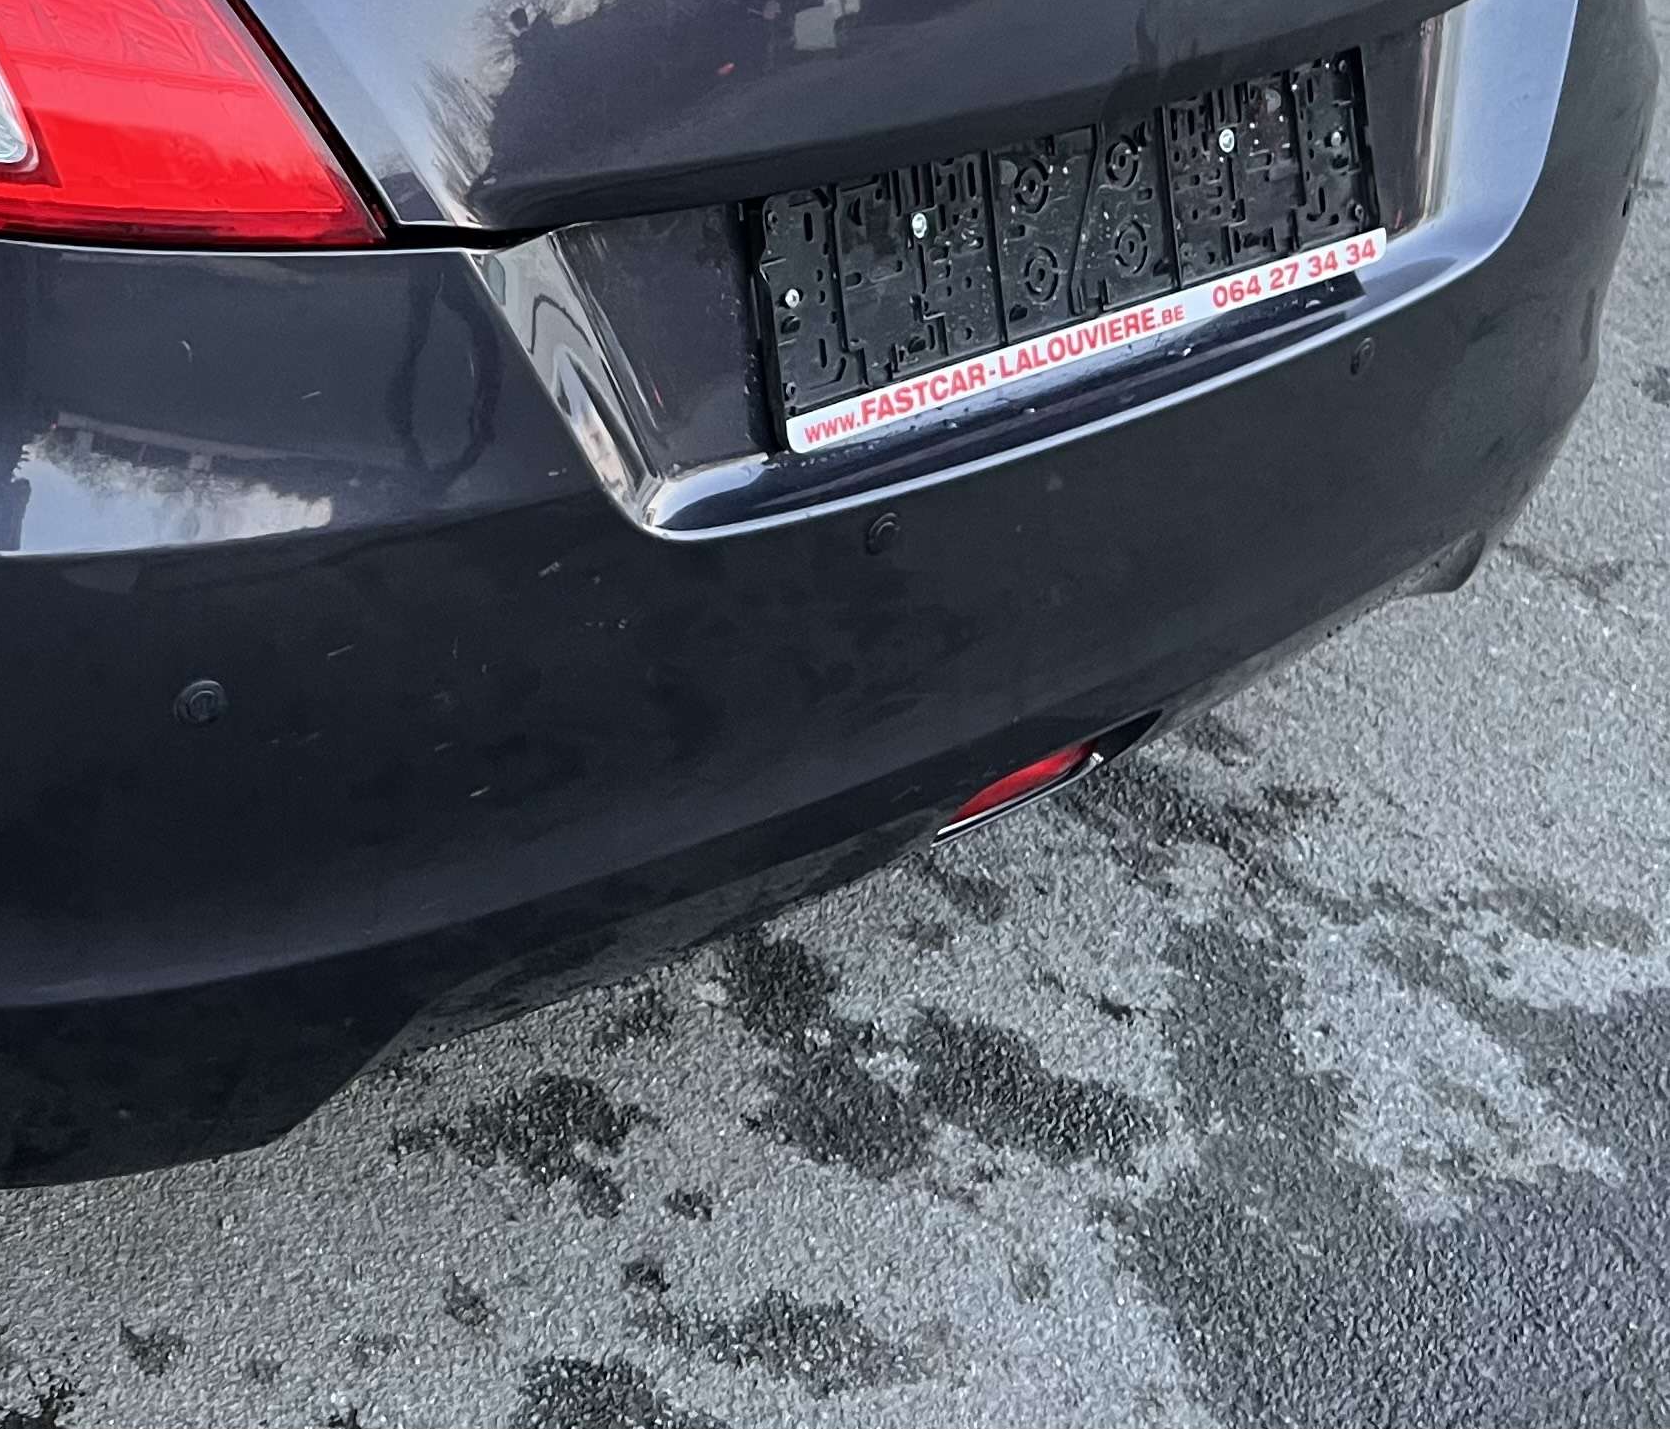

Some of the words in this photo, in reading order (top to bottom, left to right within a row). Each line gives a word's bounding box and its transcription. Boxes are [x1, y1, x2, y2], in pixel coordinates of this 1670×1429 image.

[1212, 274, 1262, 308] 064
[1269, 263, 1299, 291] 27
[1307, 251, 1339, 278] 34
[1345, 238, 1377, 265] 34
